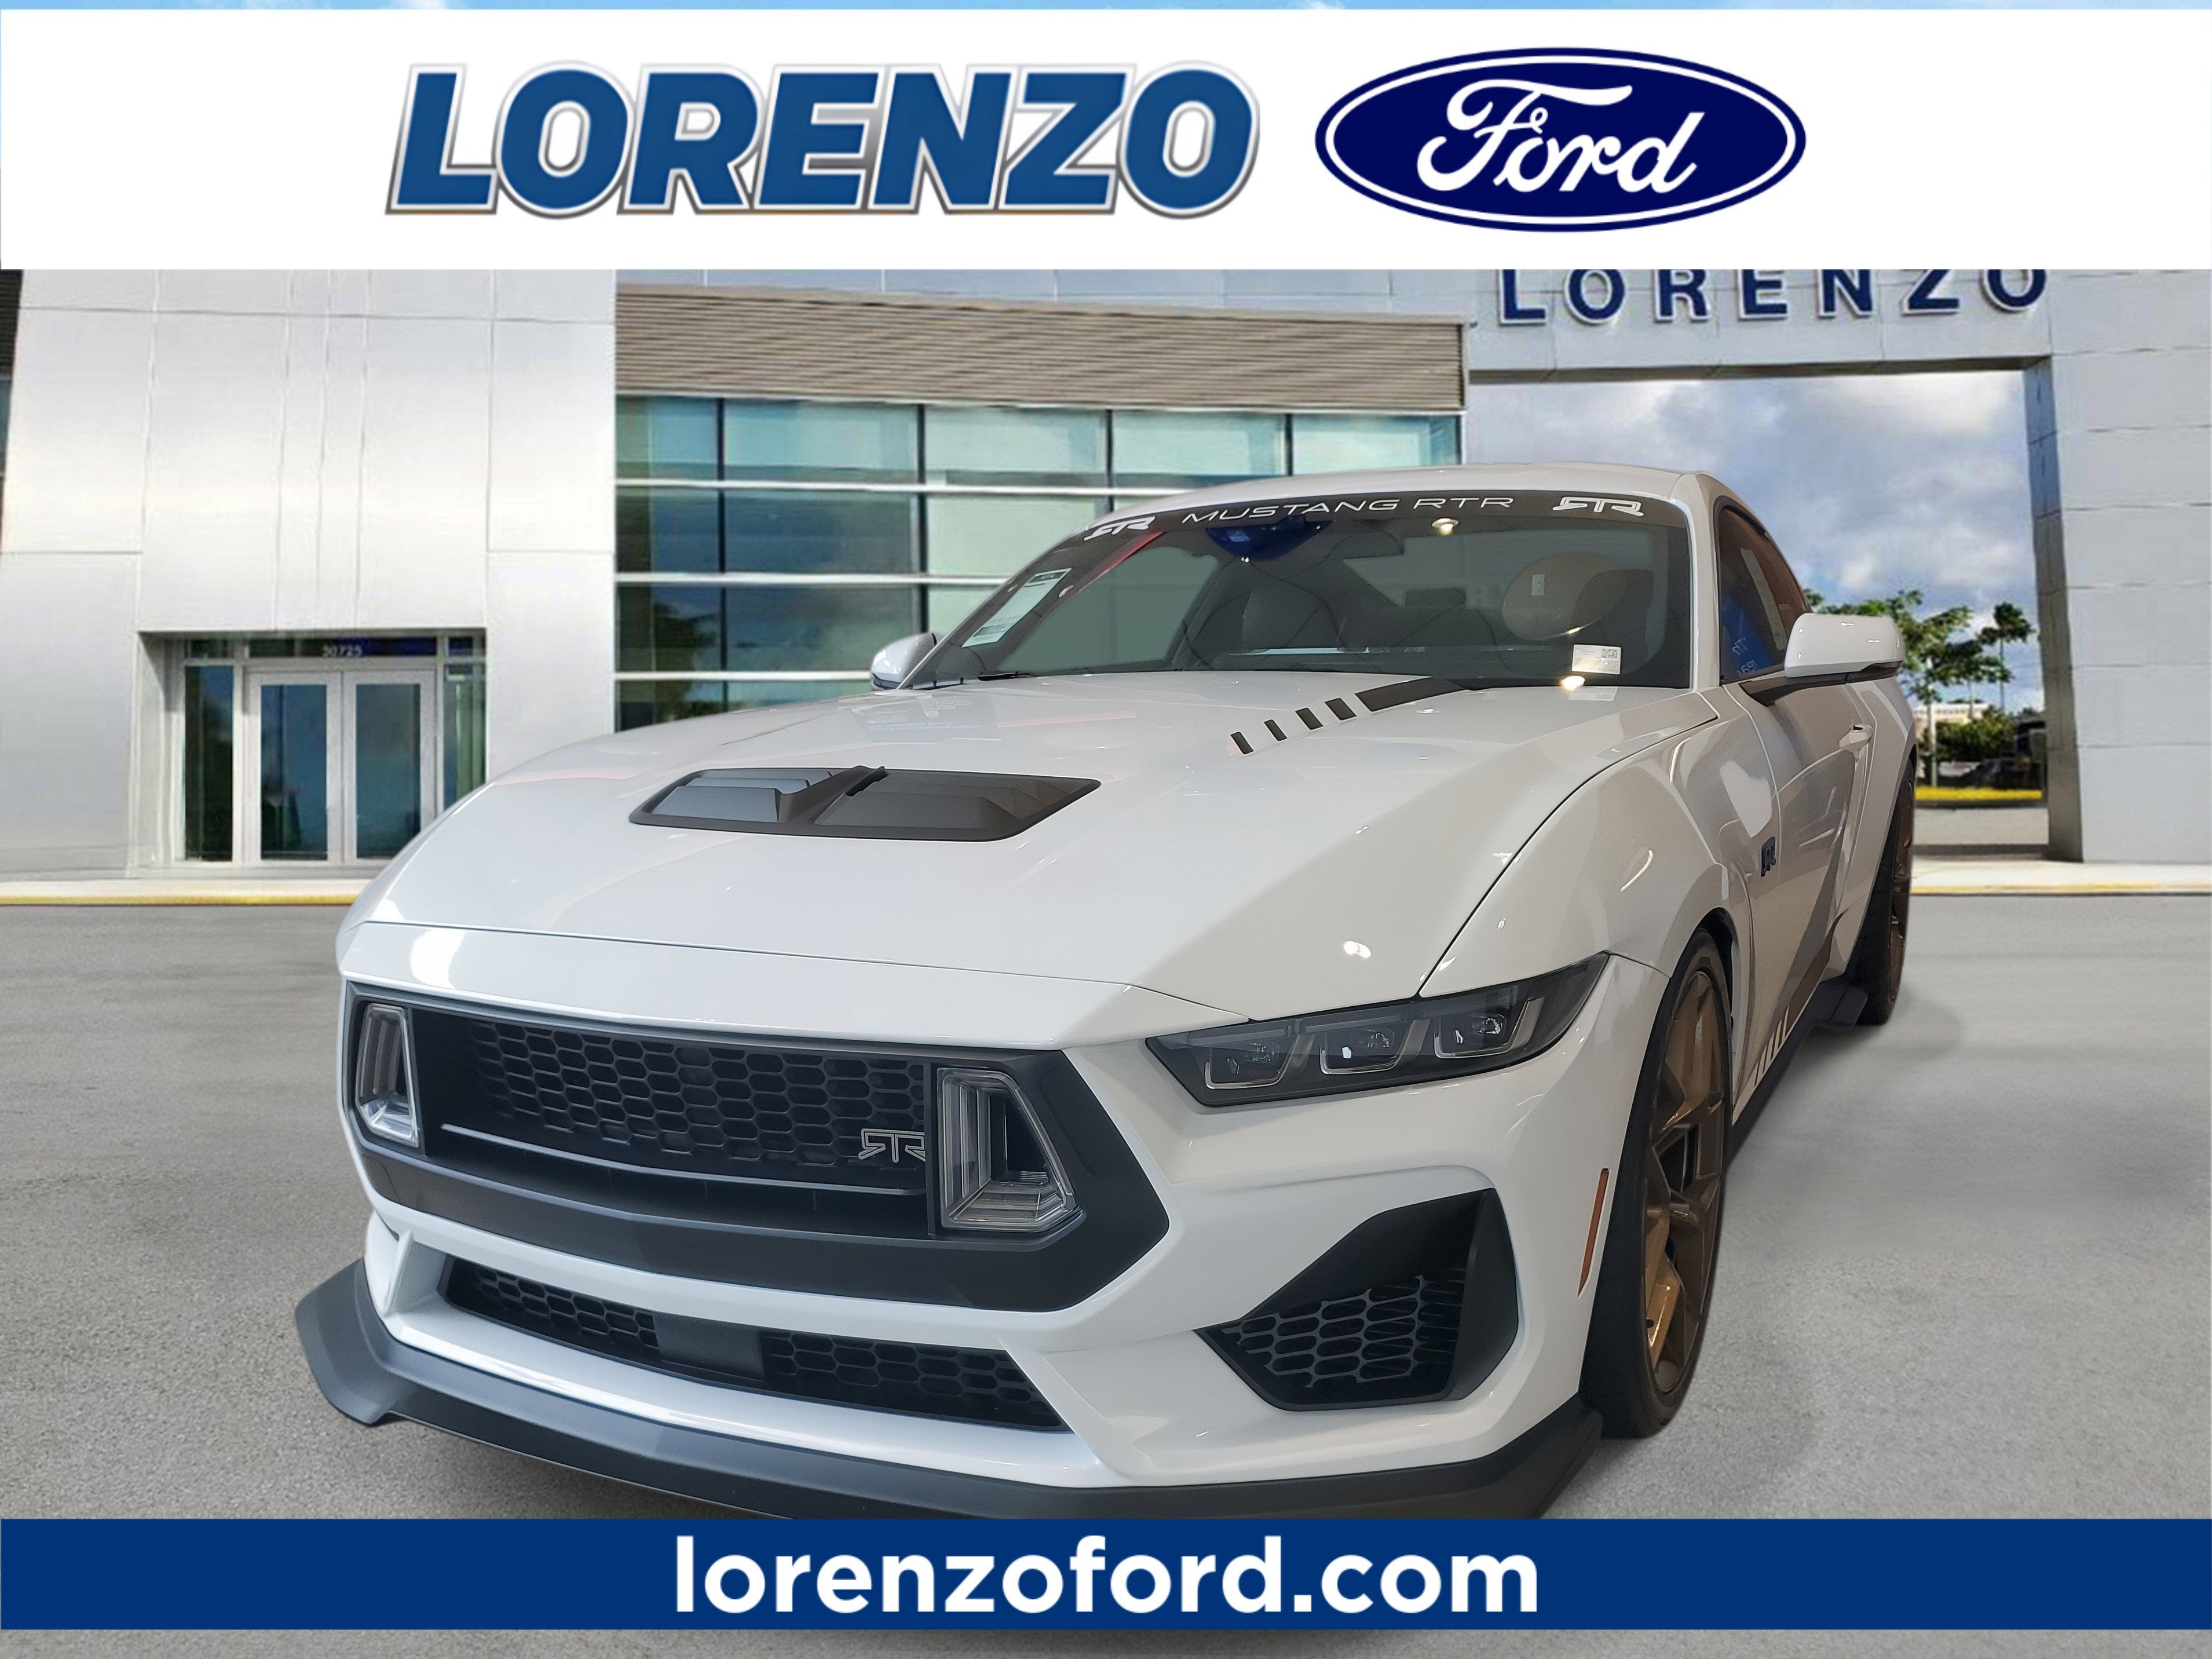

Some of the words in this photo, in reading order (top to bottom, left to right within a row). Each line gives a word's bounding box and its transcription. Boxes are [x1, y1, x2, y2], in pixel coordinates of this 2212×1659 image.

[1499, 270, 2048, 323] LORENZO
[1182, 498, 1401, 524] MUSTANG
[1413, 497, 1514, 510] RTR
